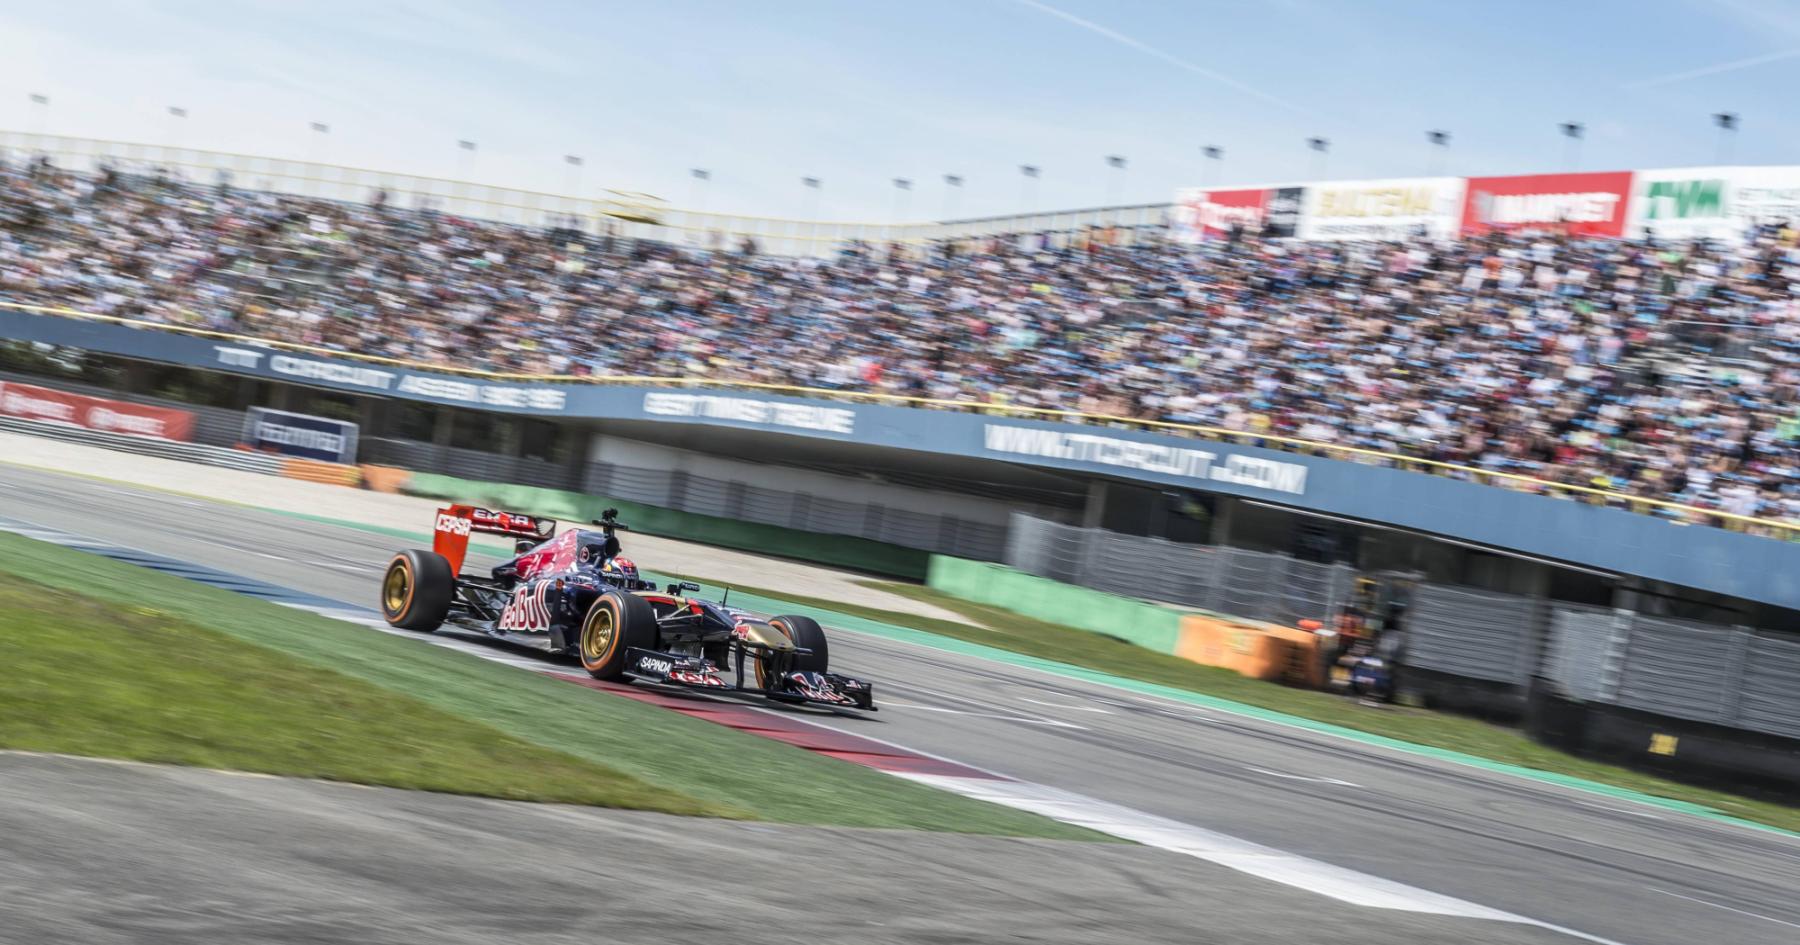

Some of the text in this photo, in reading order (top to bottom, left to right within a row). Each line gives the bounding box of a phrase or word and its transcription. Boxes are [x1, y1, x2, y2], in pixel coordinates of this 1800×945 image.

[214, 346, 265, 368] TT
[270, 355, 396, 389] CIRCUIT
[640, 656, 672, 673] SAPINDA
